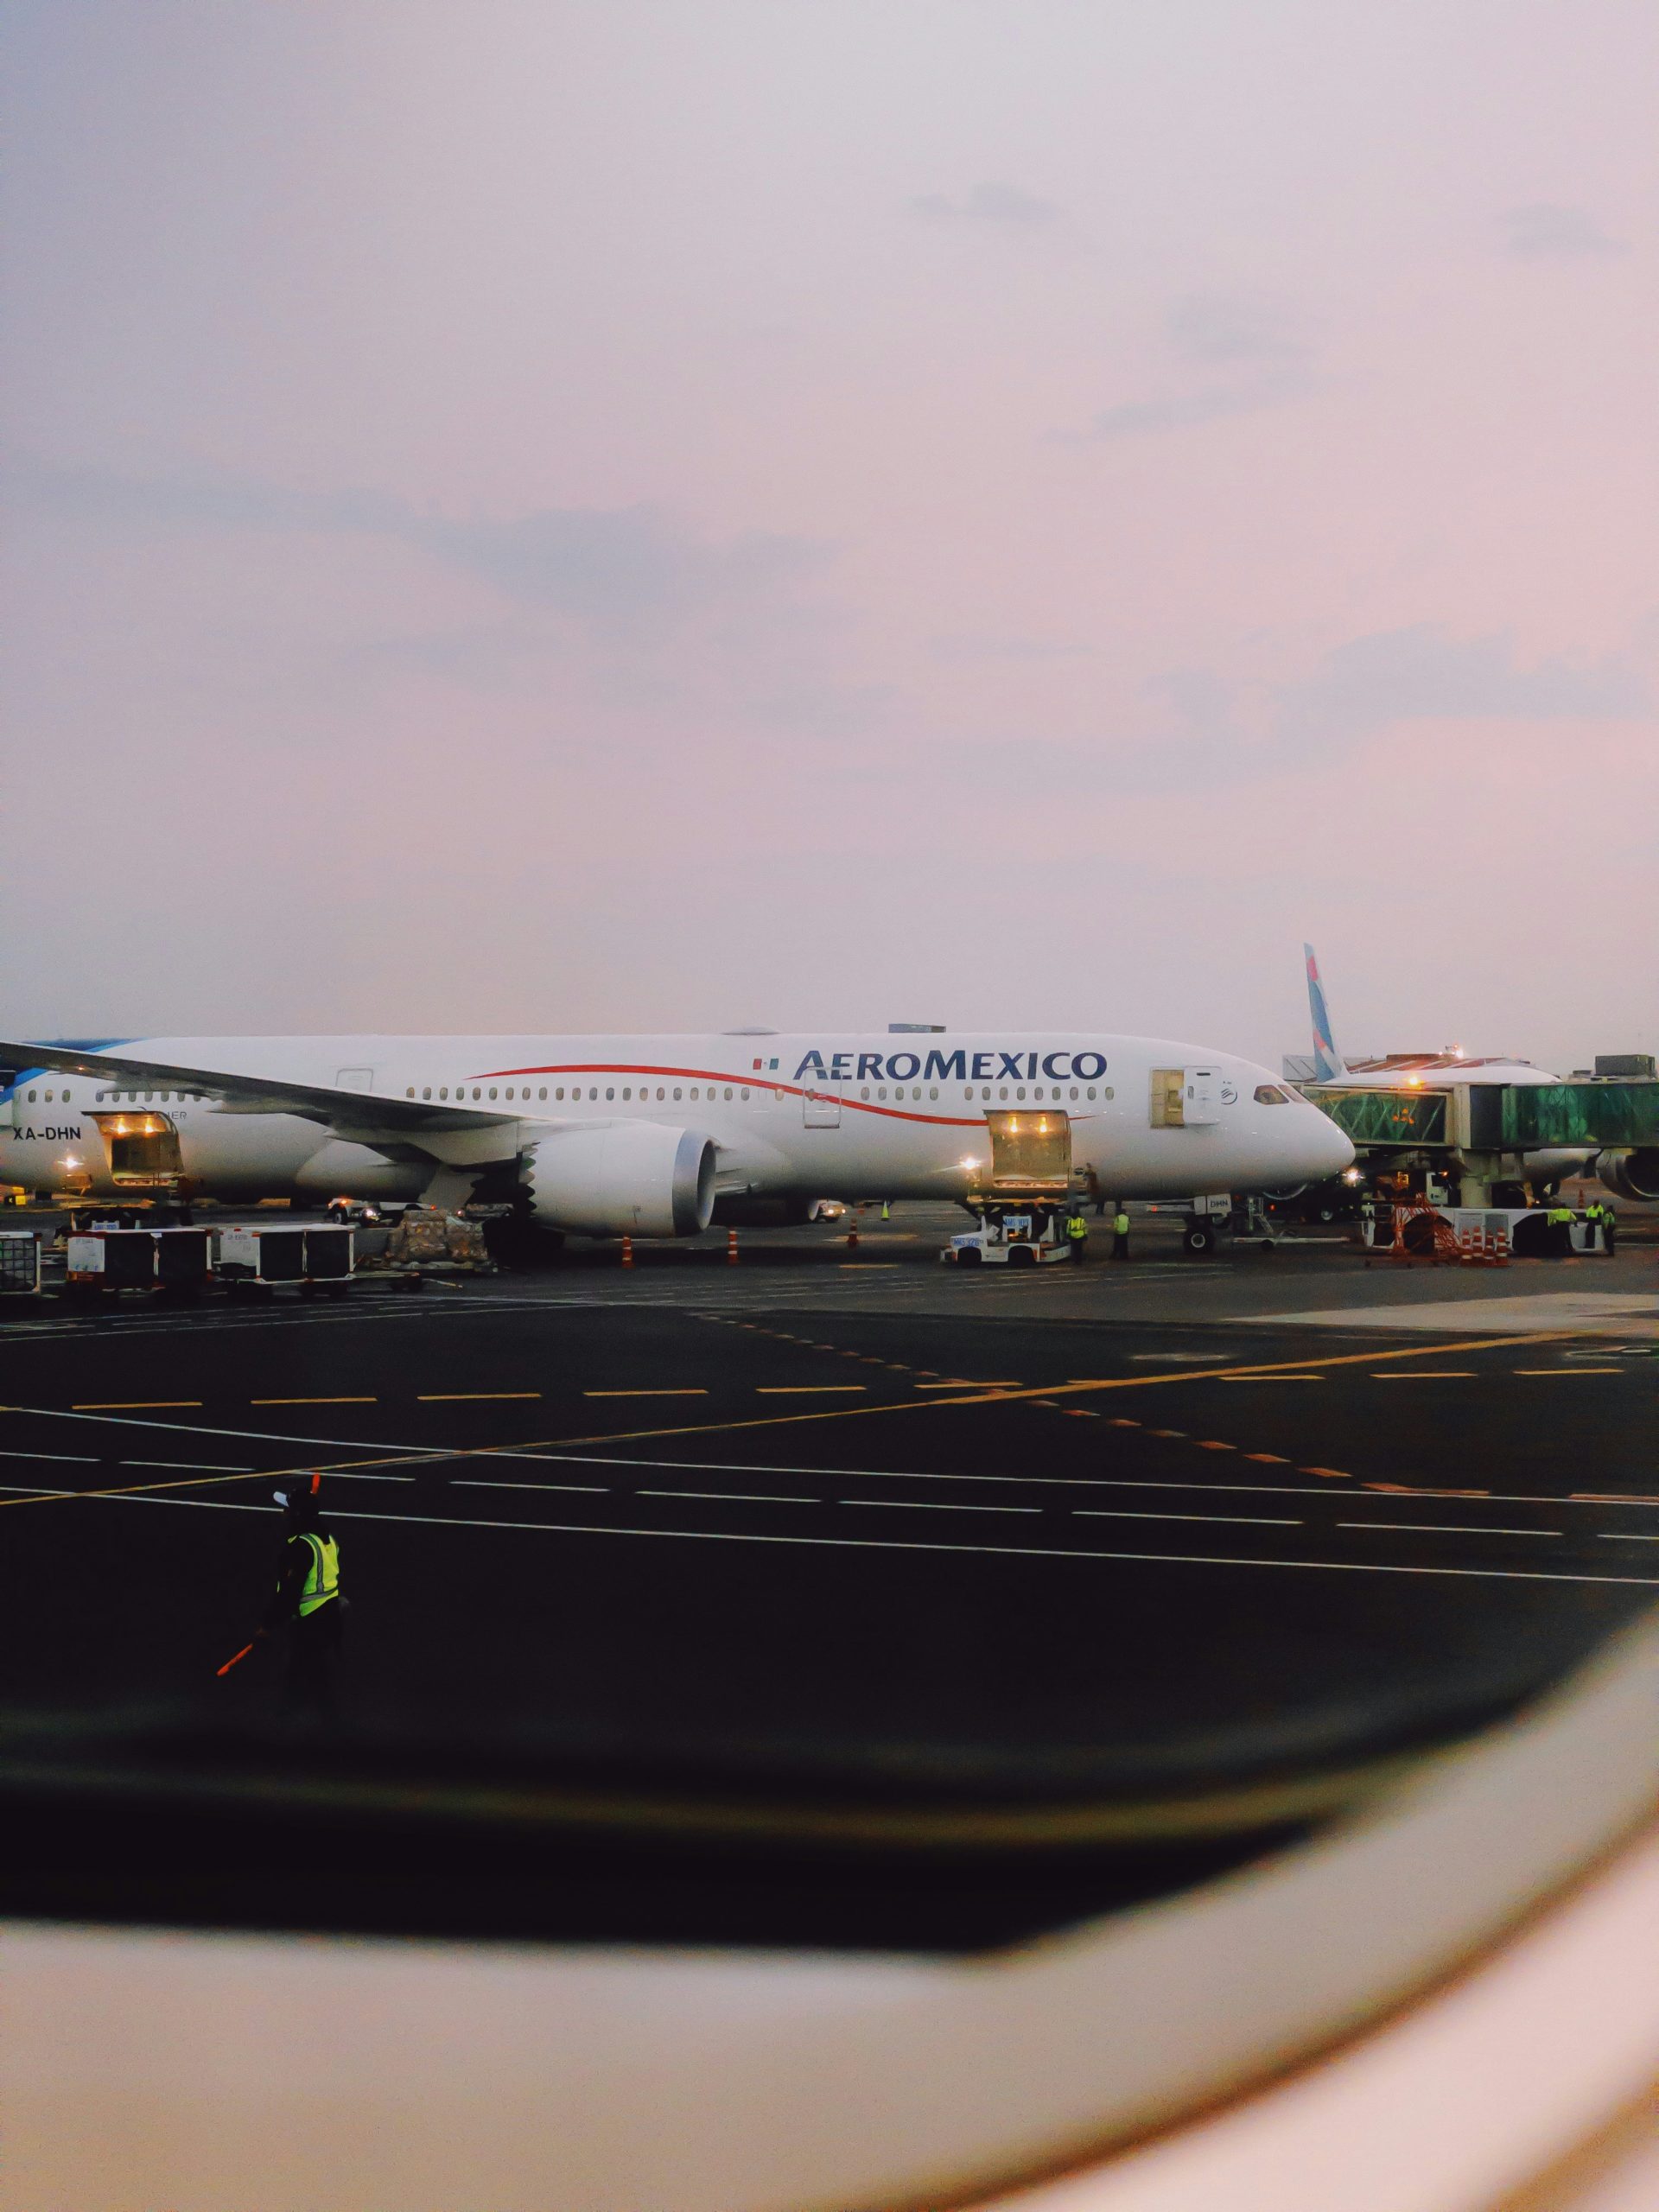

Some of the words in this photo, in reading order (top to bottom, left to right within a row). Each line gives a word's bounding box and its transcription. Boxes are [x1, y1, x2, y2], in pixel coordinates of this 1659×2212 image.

[792, 1050, 1107, 1080] AEROMEXICO
[13, 1127, 81, 1141] XA-DHN
[1210, 1198, 1229, 1208] DHN
